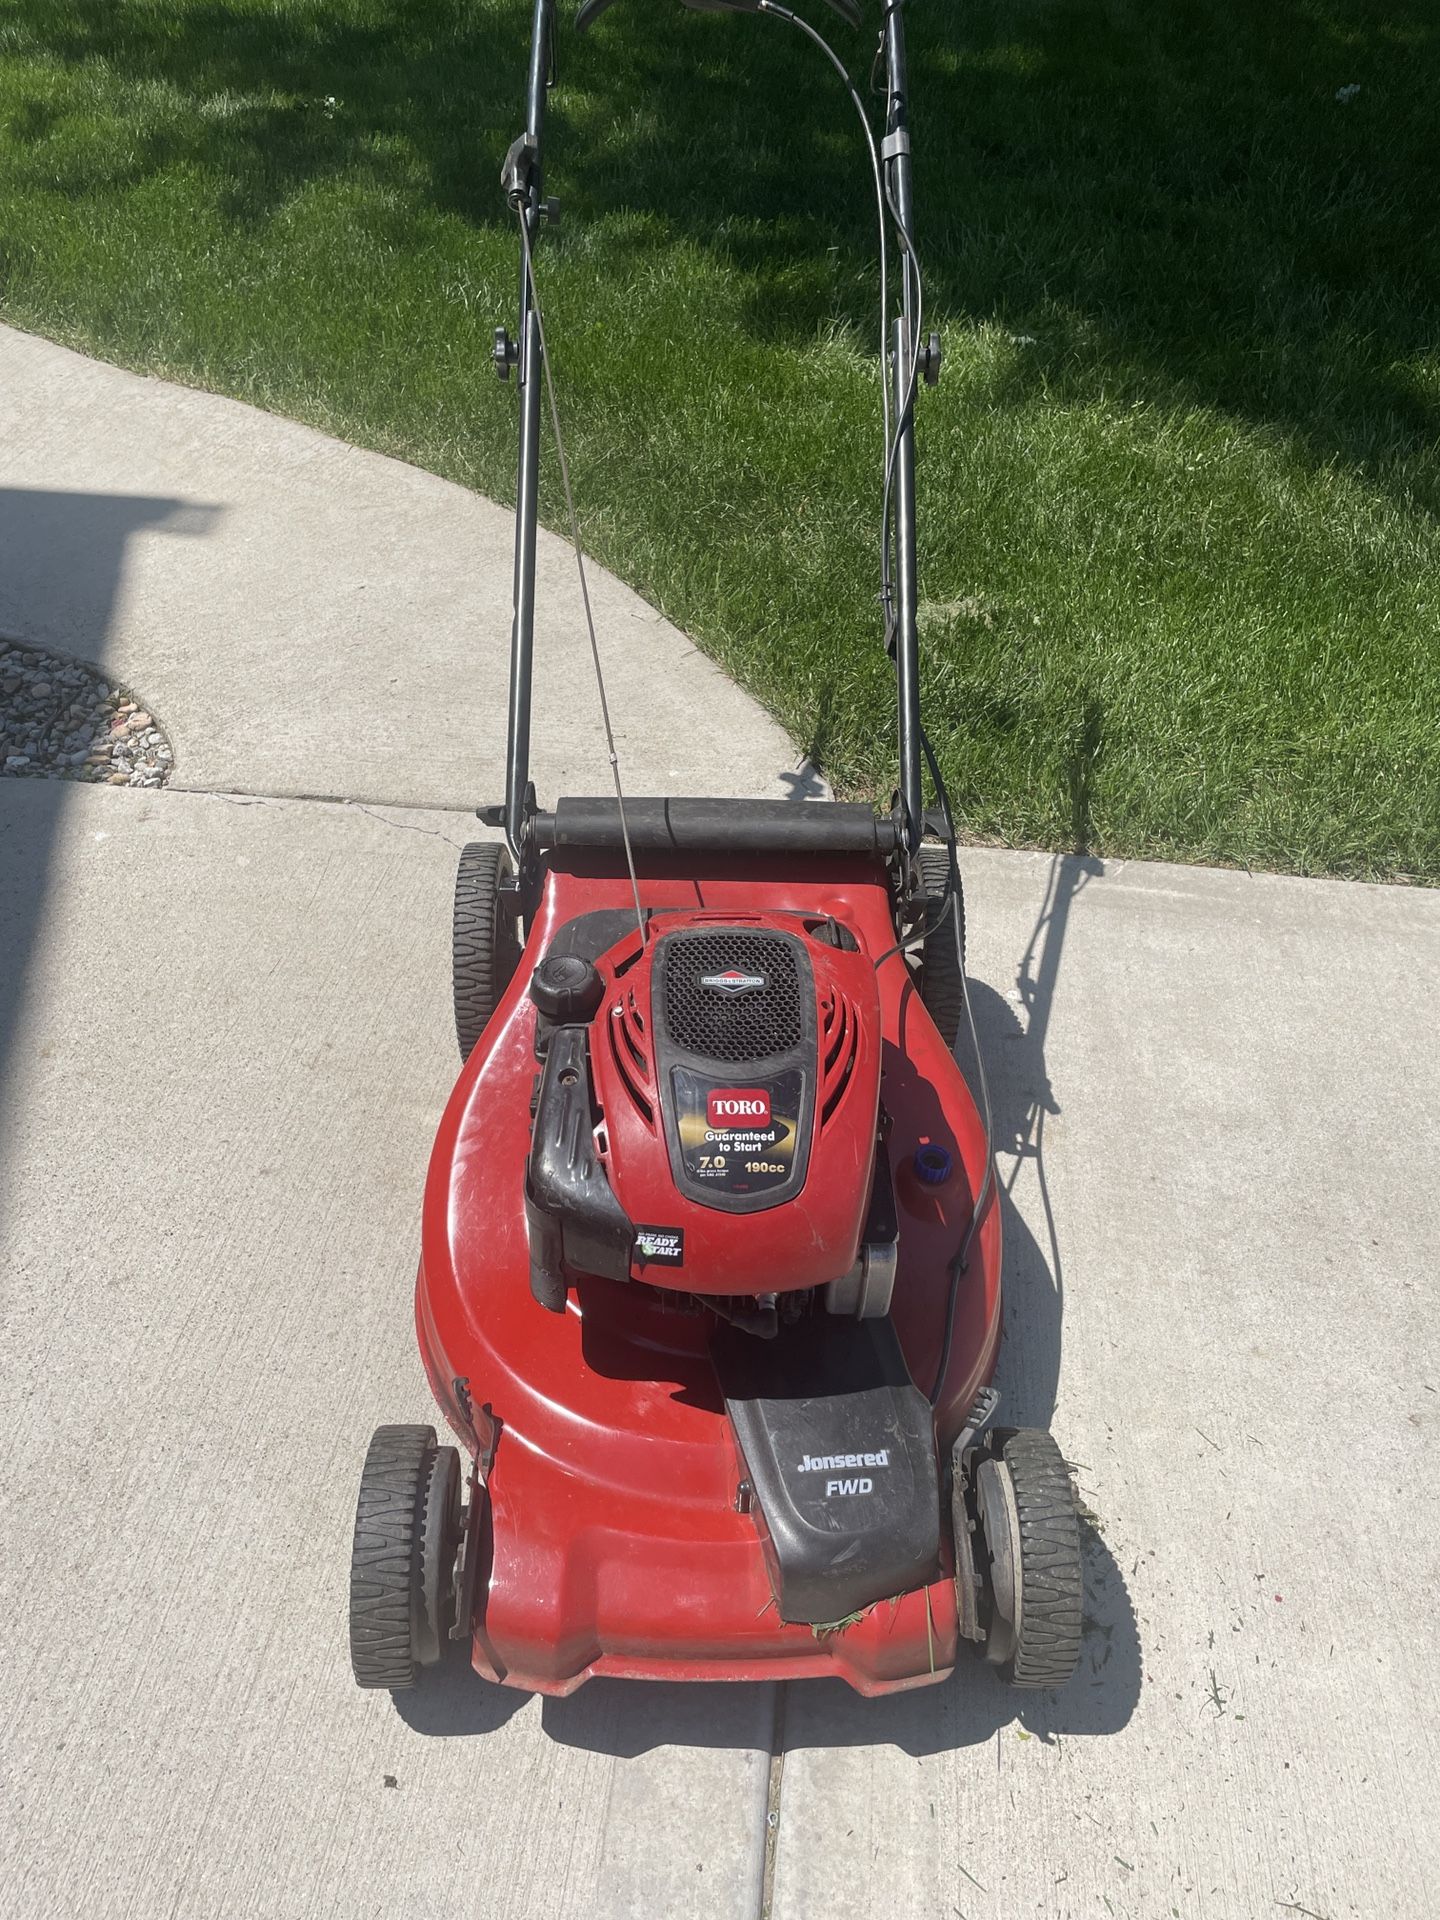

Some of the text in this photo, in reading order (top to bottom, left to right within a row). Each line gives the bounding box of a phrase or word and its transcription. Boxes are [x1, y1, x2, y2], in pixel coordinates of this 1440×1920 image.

[705, 1130, 775, 1141] Guaranteed
[719, 1141, 762, 1152] to Start
[699, 1155, 726, 1169] 7.0
[745, 1162, 785, 1173] 190cc
[635, 1235, 678, 1247] READY
[642, 1245, 682, 1256] START
[797, 1449, 889, 1473] Jonsered
[826, 1478, 873, 1497] FWD
